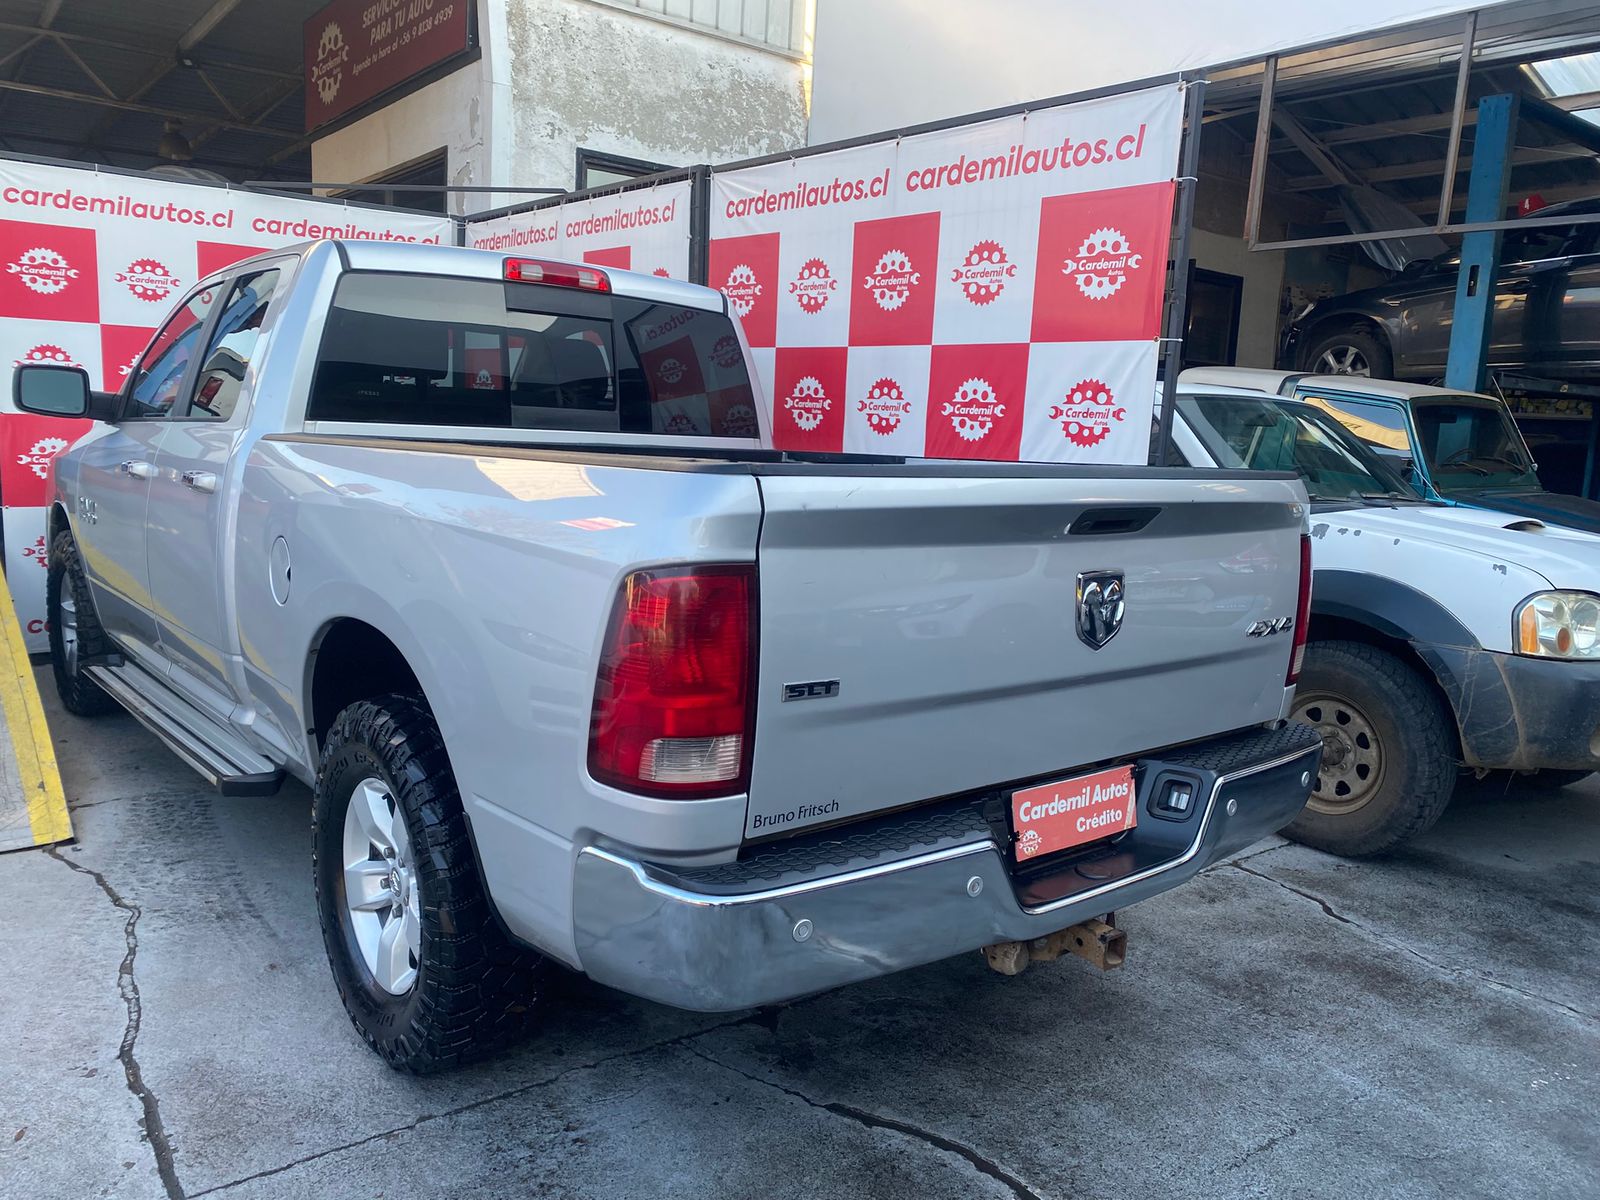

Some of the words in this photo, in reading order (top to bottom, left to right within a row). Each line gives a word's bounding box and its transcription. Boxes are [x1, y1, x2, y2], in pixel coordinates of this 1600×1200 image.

[369, 17, 392, 46] PARA
[394, 7, 407, 30] TU
[905, 123, 1147, 192] cardemilautos.cl
[725, 168, 890, 218] cardemilautos.cl
[3, 187, 234, 228] cardemilautos.cl
[565, 199, 675, 238] cardemilautos.cl
[251, 216, 440, 245] cardemilautl
[473, 220, 558, 250] cardemilautos.cl
[22, 265, 65, 276] Cardemil
[1078, 256, 1126, 272] Cardemil
[128, 274, 169, 286] Cardemil
[874, 274, 909, 287] Cardemil
[964, 267, 1004, 280] Cardemil
[728, 284, 754, 296] Cardemil
[798, 281, 828, 292] Cardemil
[793, 398, 824, 410] Cardemil
[868, 401, 902, 412] Cardemil
[954, 404, 993, 416] Cardemil
[1065, 408, 1110, 420] Cardemil
[787, 681, 839, 699] SLT
[1019, 787, 1091, 822] Cardemil
[1092, 783, 1128, 805] Autos
[753, 809, 795, 829] Bruno
[798, 800, 839, 820] Fritsch
[1076, 808, 1123, 833] Crédito
